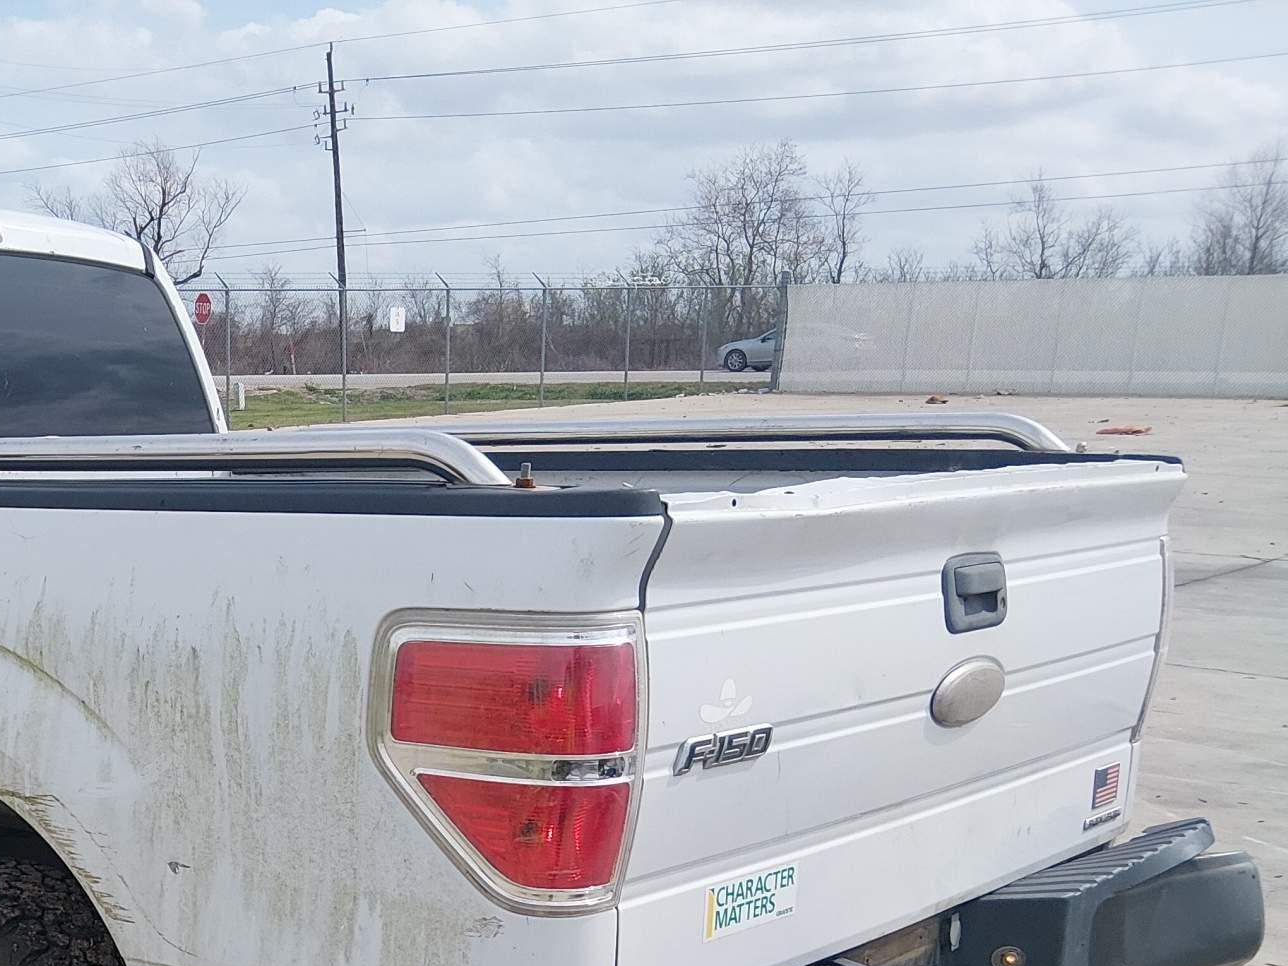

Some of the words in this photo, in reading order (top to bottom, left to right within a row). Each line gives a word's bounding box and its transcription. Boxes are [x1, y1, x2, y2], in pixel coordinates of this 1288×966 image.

[195, 302, 210, 314] STOP
[716, 866, 795, 908] CHARACTER
[714, 893, 776, 930] MATTERS
